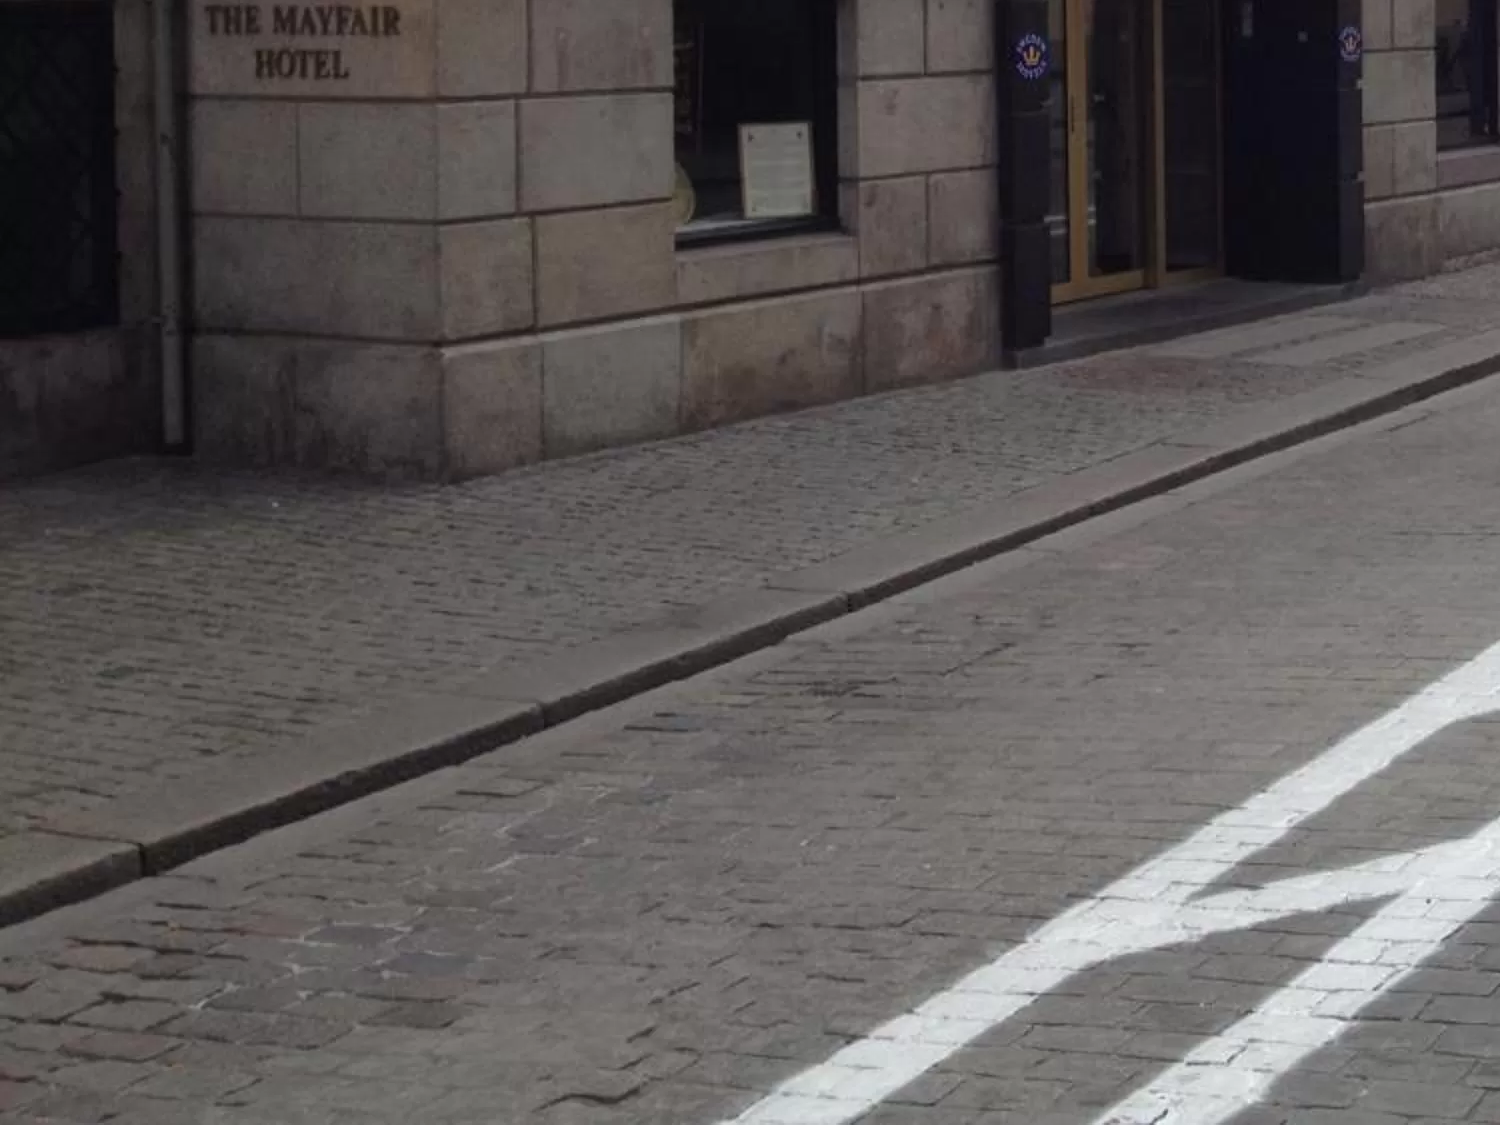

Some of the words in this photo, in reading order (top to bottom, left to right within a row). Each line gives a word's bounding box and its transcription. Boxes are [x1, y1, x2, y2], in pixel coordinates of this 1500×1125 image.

[205, 5, 260, 37] THE
[273, 5, 401, 37] MAYFAIR
[254, 47, 350, 80] HOTEL
